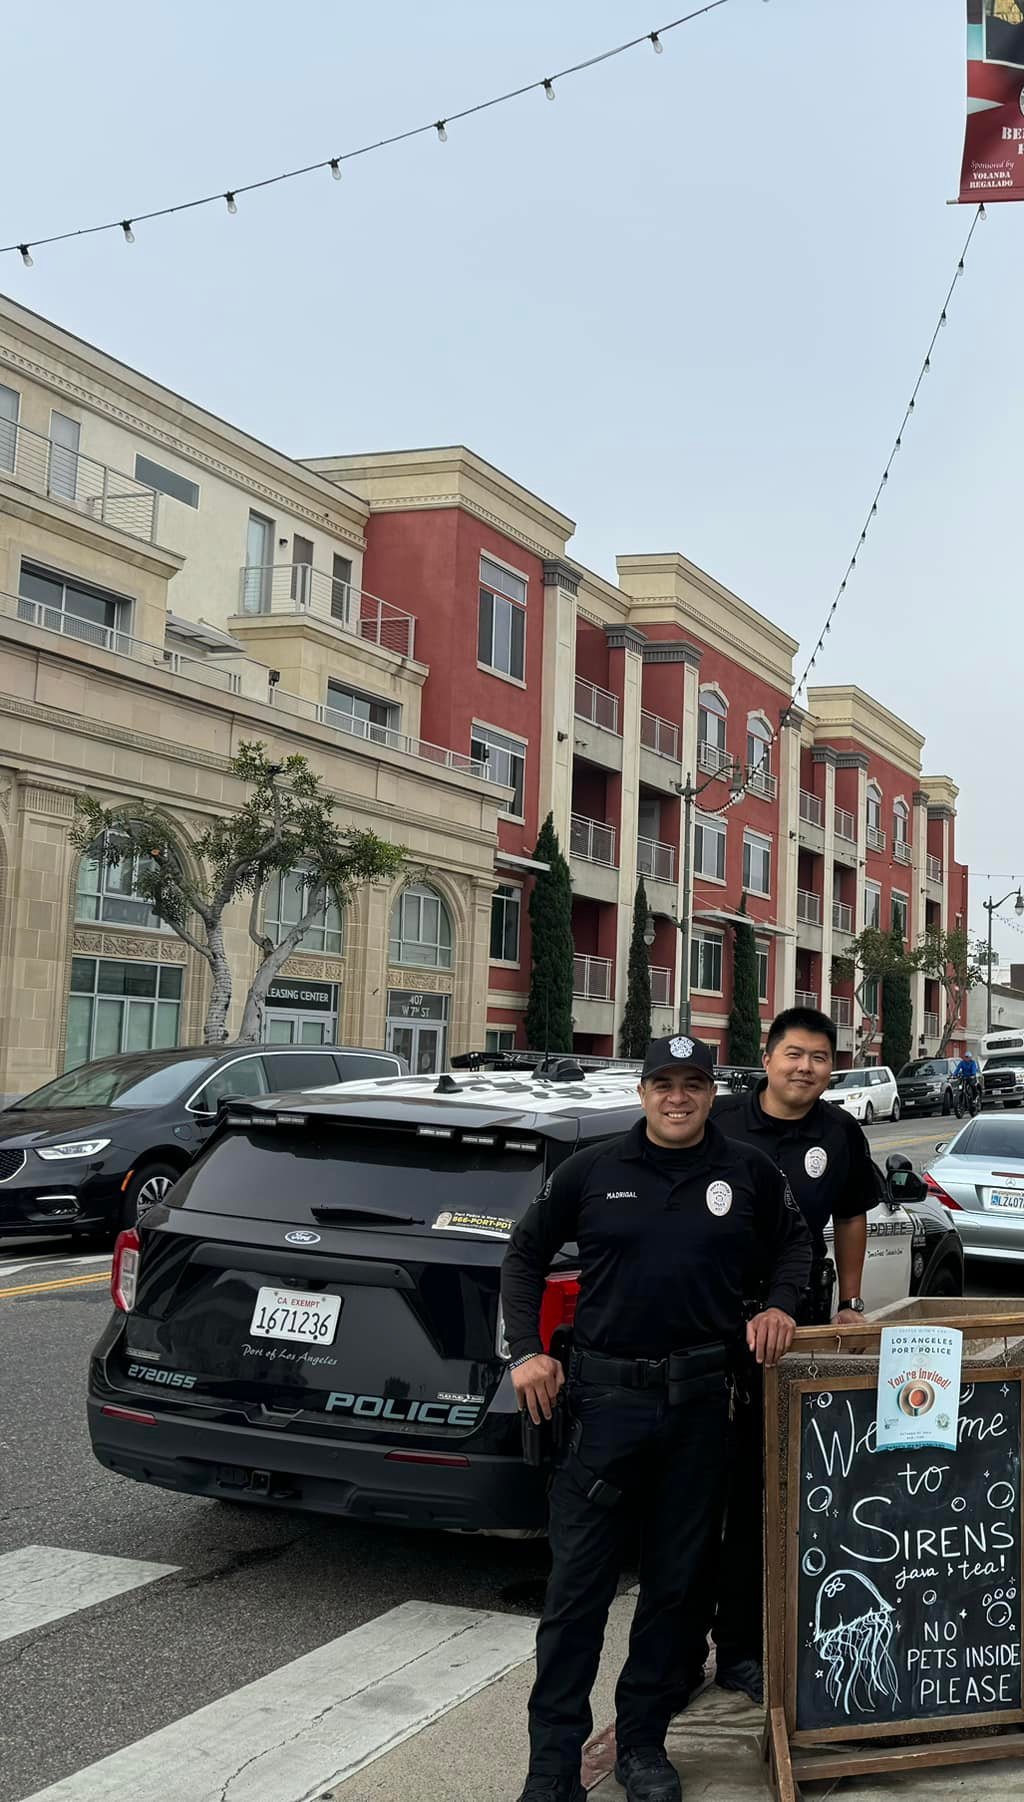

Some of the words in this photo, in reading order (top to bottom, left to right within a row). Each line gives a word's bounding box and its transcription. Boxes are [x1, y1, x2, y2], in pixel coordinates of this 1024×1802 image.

[970, 160, 1003, 170] Sponsored
[1005, 160, 1015, 171] by
[969, 180, 1014, 189] REGALADO
[973, 172, 1011, 180] YOLANDA
[266, 988, 299, 1000] LEASING
[300, 990, 329, 1002] CENTER
[409, 995, 423, 1005] 407
[401, 1006, 409, 1016] W
[421, 1007, 430, 1017] ST
[606, 1191, 638, 1200] MADRIGAL
[277, 1297, 287, 1305] CA
[291, 1299, 320, 1308] EXEMPT
[255, 1306, 332, 1337] 1671236
[891, 1337, 907, 1345] LOS
[911, 1337, 953, 1346] ANGELES
[918, 1347, 952, 1355] POLICE
[240, 1344, 263, 1356] Port
[265, 1348, 277, 1361] of
[278, 1348, 296, 1360] Los
[296, 1352, 338, 1366] Angeles
[127, 1364, 198, 1389] 2720155
[888, 1370, 917, 1389] You're
[324, 1392, 481, 1426] POLICE
[811, 1400, 1008, 1478] Weme
[897, 1463, 950, 1495] to
[894, 1562, 939, 1590] java
[957, 1554, 1006, 1580] tea!
[923, 1620, 958, 1643] NO
[907, 1648, 957, 1671] PETS
[965, 1643, 1021, 1668] INSIDE
[920, 1674, 1013, 1705] PLEASE
